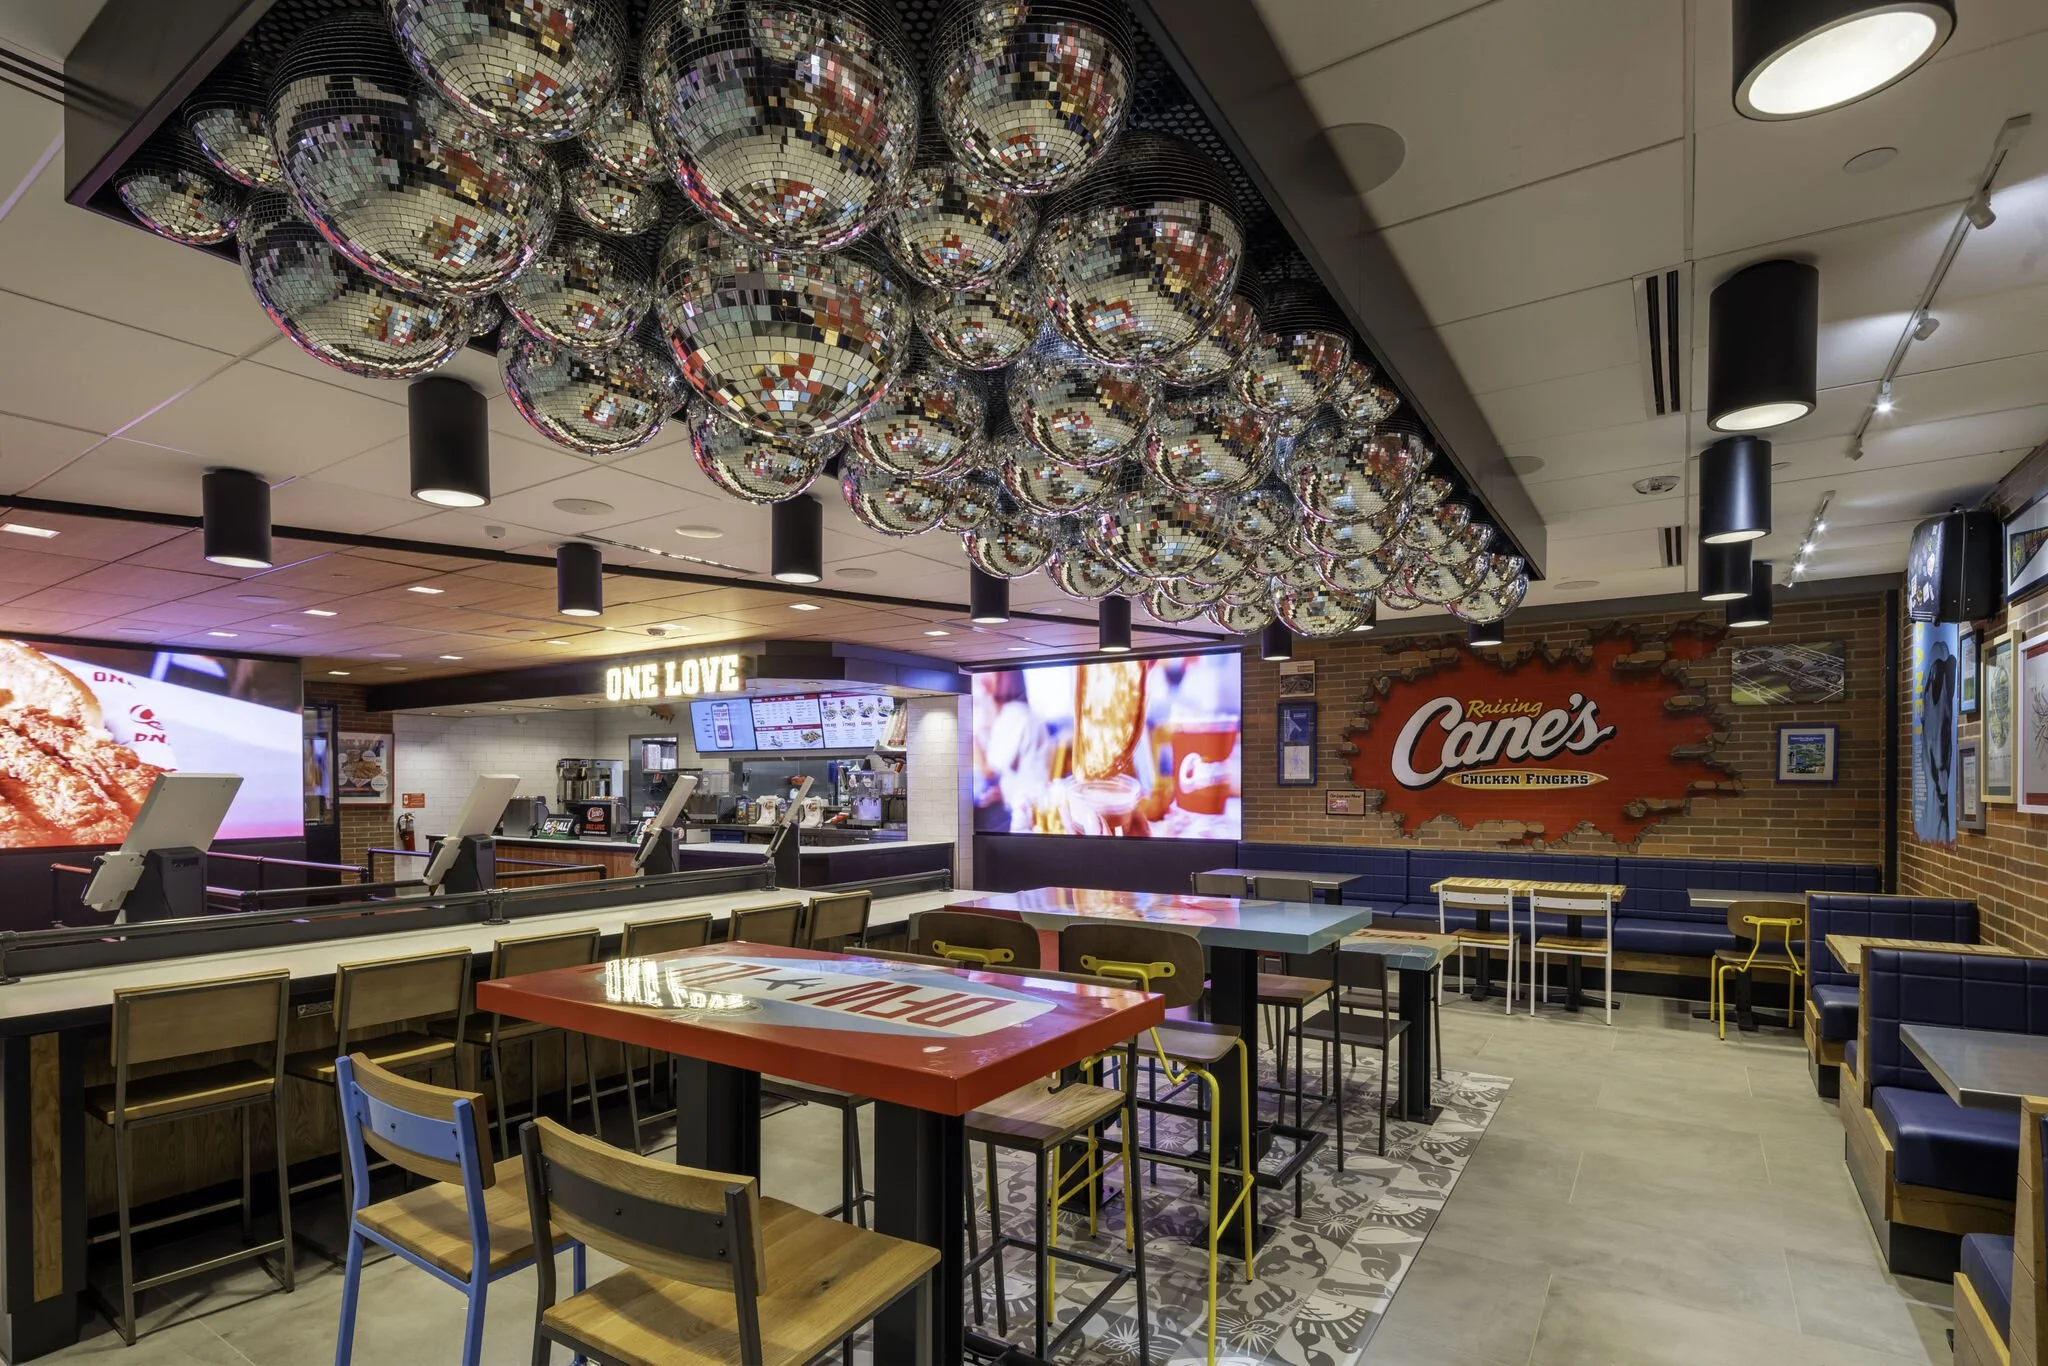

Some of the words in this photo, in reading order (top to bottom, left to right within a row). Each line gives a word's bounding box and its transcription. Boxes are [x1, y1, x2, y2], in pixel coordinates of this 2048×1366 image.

[606, 663, 659, 702] ONE
[664, 654, 739, 697] LOVE
[1465, 698, 1544, 718] Raising
[1391, 692, 1617, 790] Cane's
[1460, 773, 1521, 786] CHICKEN
[1525, 773, 1589, 786] FINGERS
[786, 981, 1016, 1028] DFW
